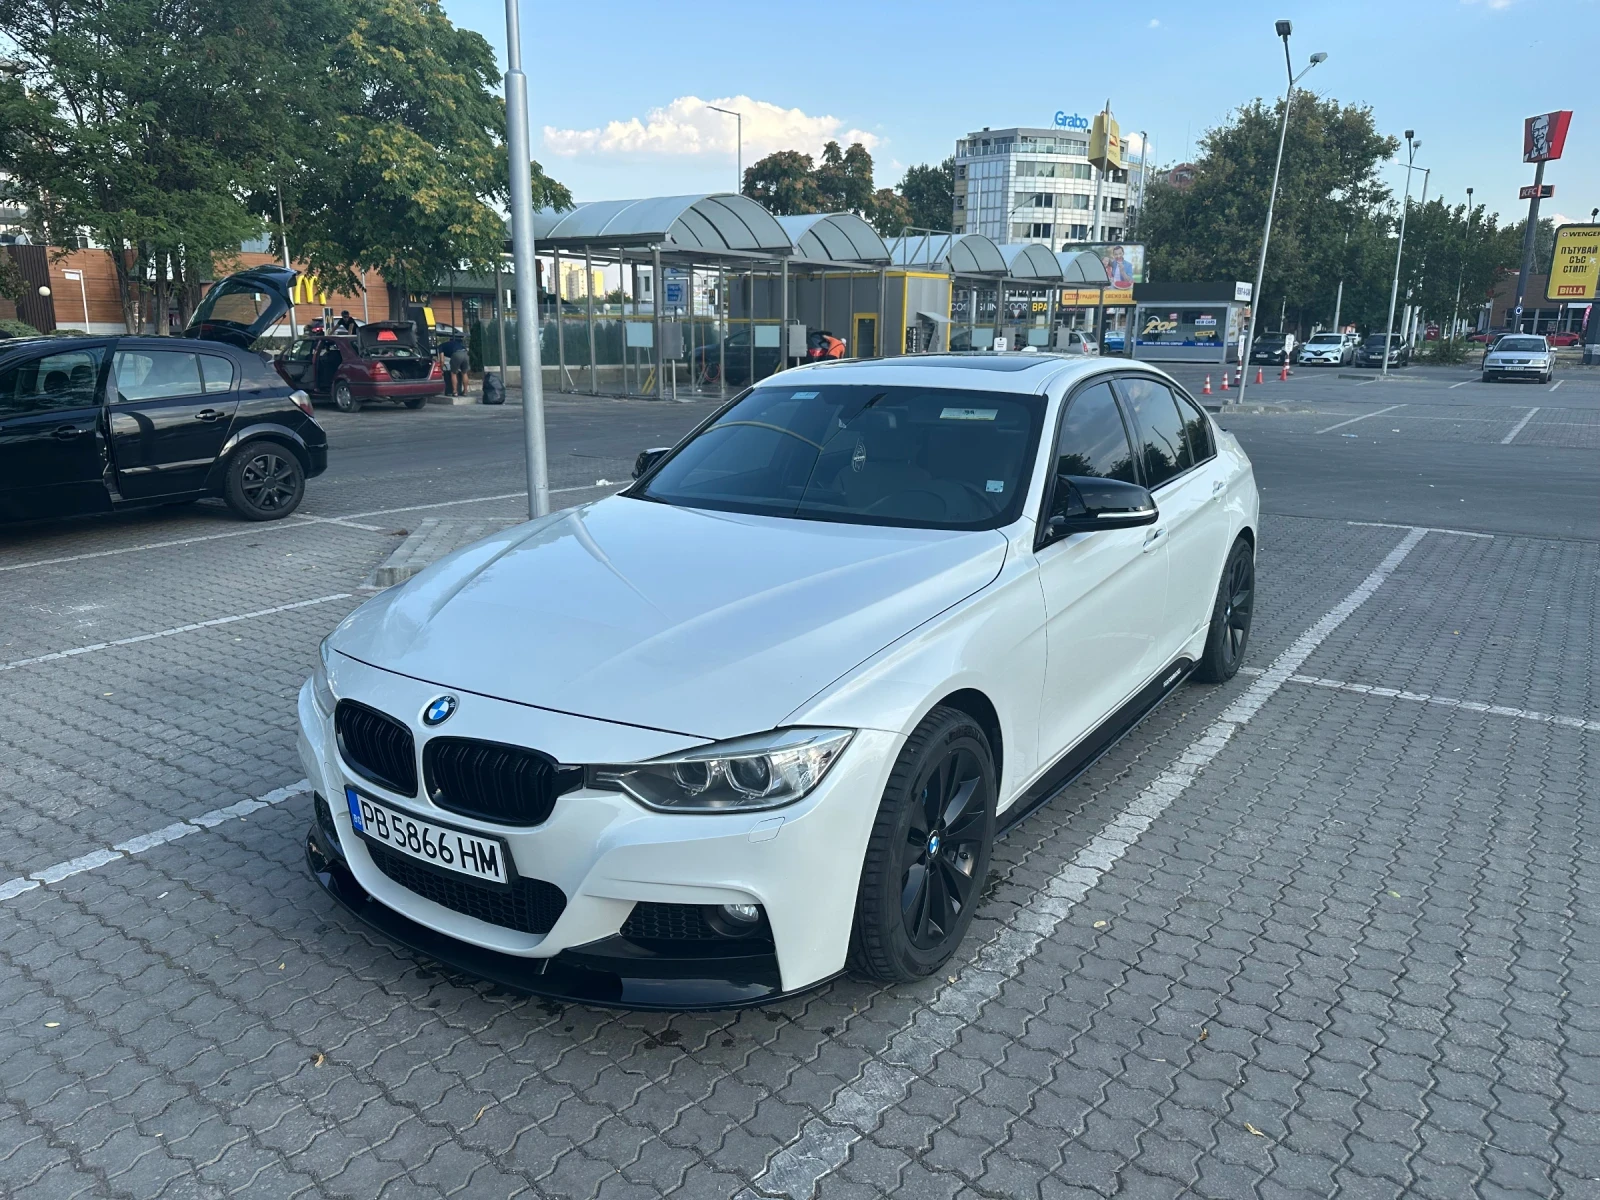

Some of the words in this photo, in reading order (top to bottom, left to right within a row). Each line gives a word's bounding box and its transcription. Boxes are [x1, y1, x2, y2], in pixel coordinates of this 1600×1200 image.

[1054, 111, 1088, 128] Grabo
[1521, 188, 1537, 196] KFC
[1560, 245, 1598, 255] ПЪТУВАЙ
[1569, 256, 1586, 264] СЪС
[1559, 286, 1584, 295] BILLA
[1142, 321, 1178, 335] TOP
[353, 813, 363, 826] BG
[360, 800, 390, 840] PB
[391, 814, 455, 864] 5866
[457, 836, 500, 878] HM
